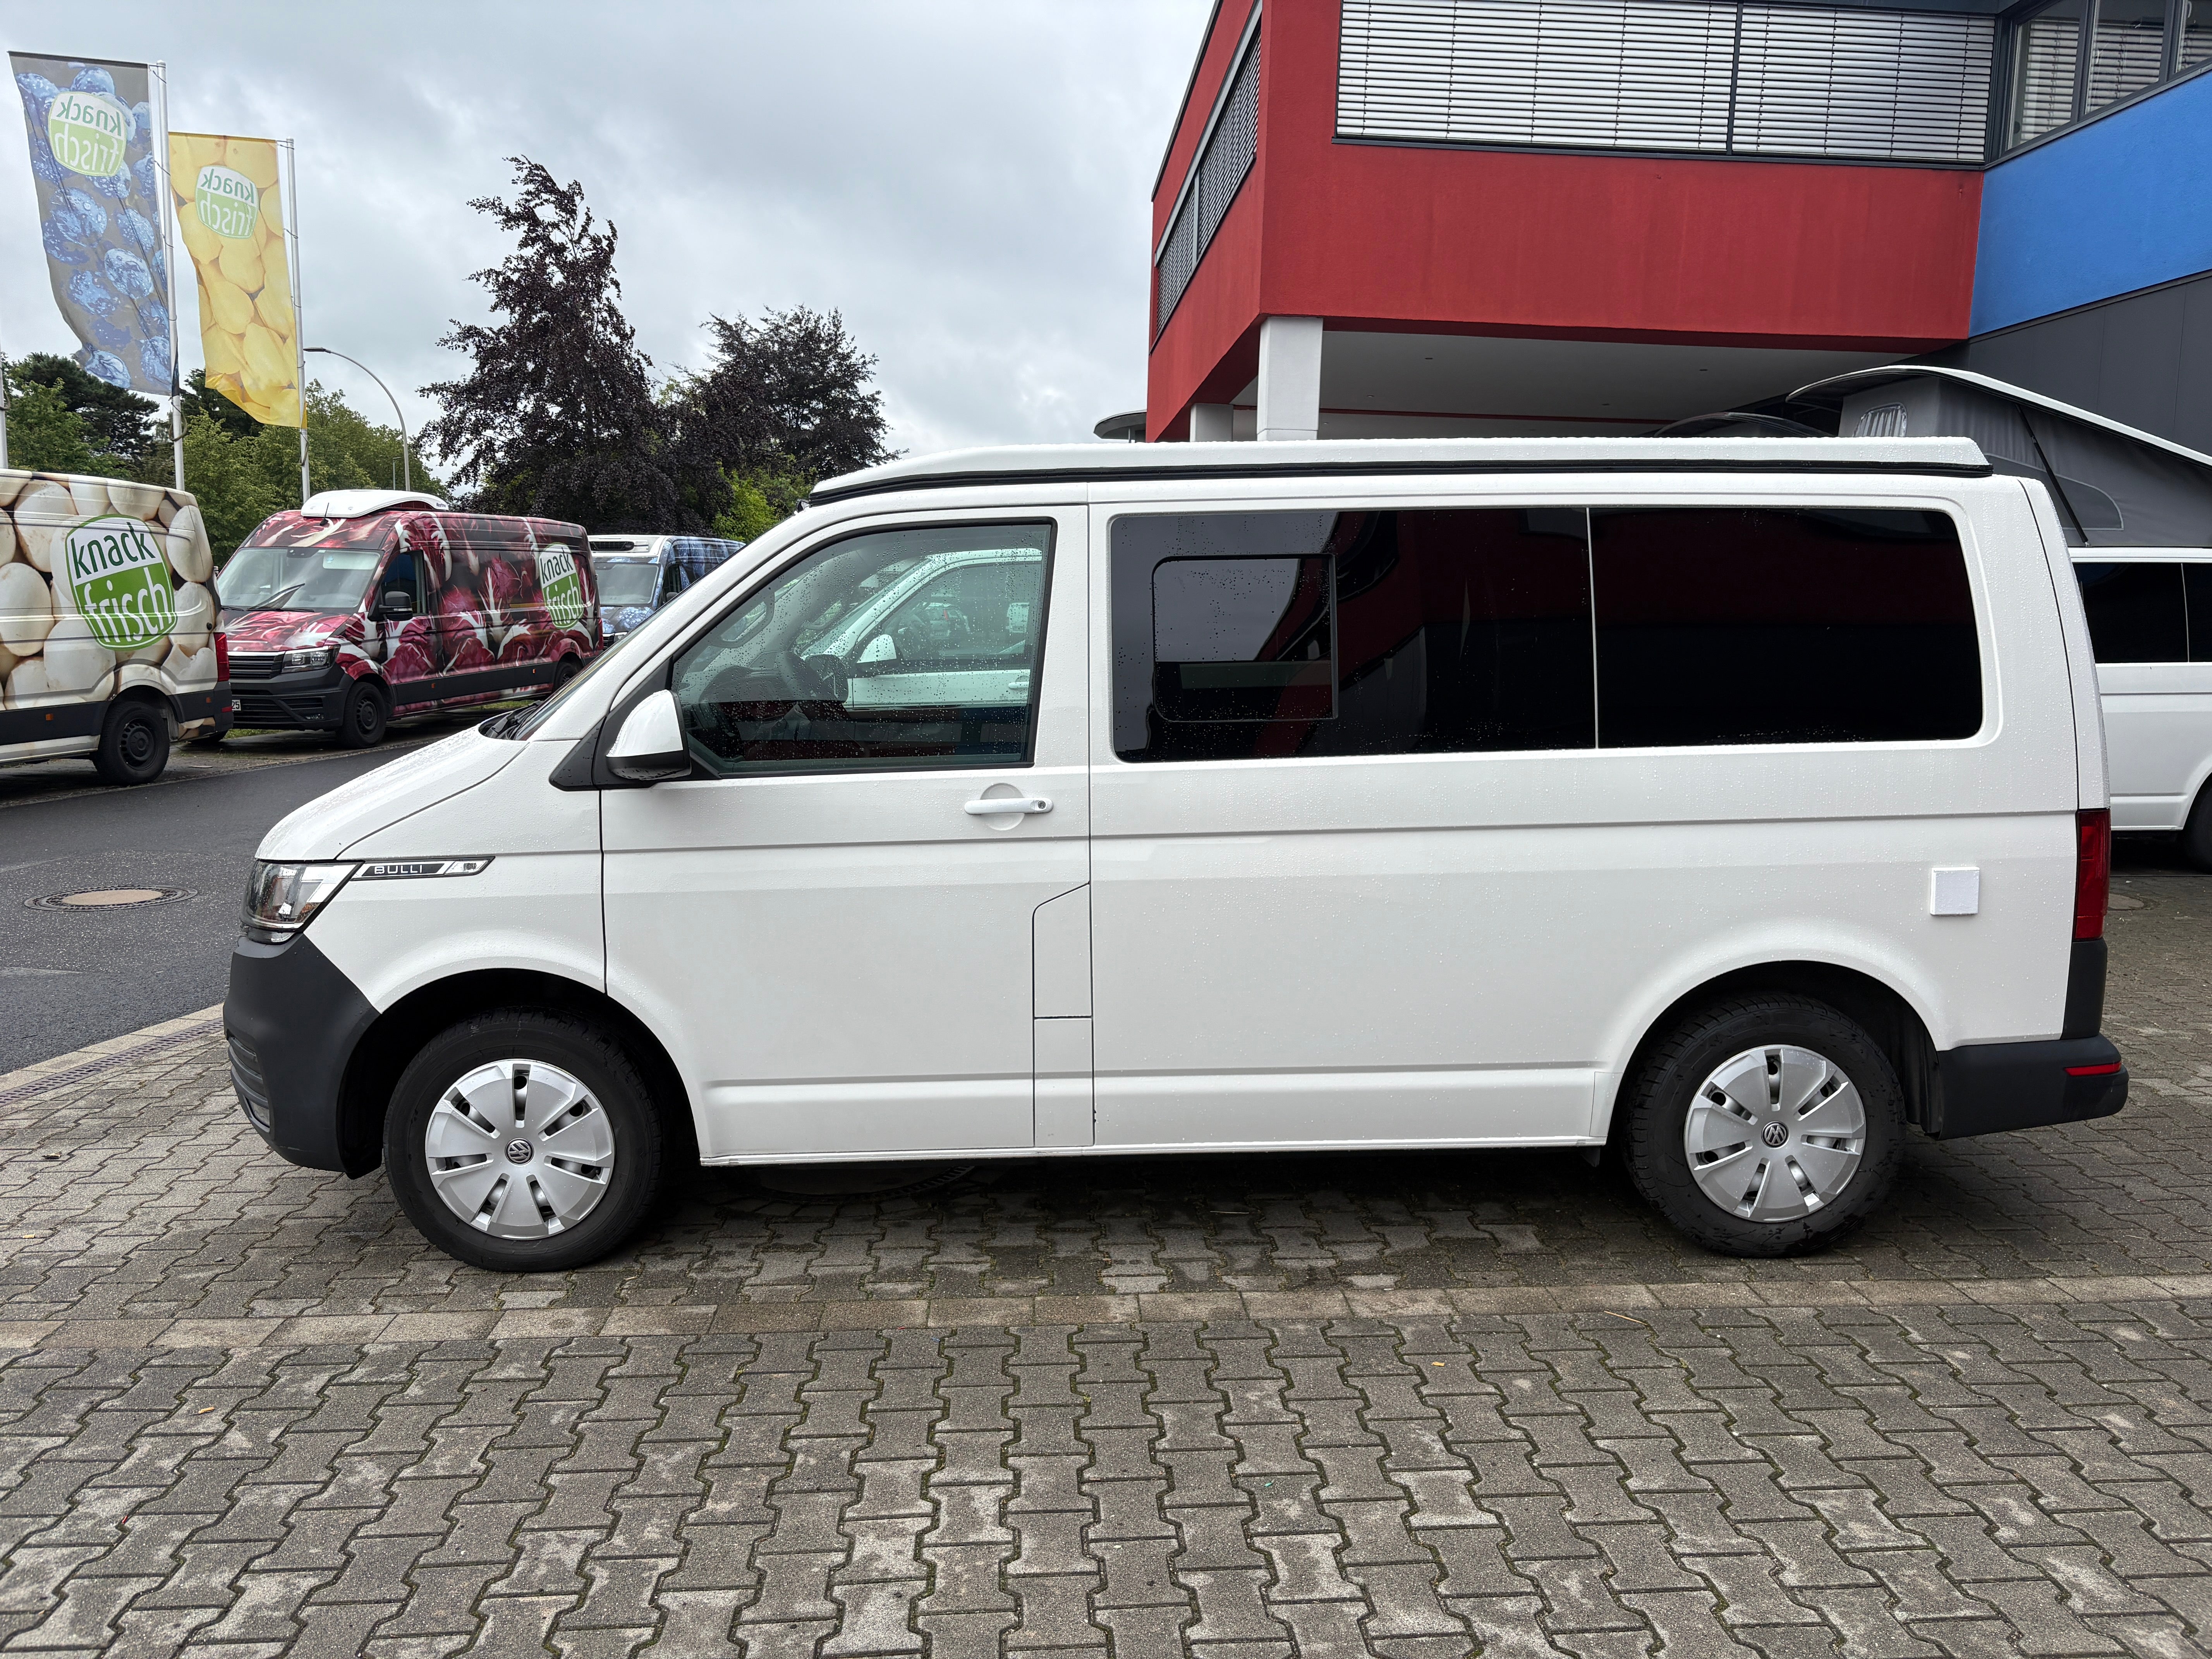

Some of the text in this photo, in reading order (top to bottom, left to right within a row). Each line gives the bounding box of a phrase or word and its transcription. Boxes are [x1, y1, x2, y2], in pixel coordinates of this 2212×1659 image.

[70, 522, 156, 579] knack
[540, 547, 573, 584] knack
[84, 567, 172, 642] frisch
[546, 575, 582, 625] frisch
[374, 864, 422, 874] BULLI
